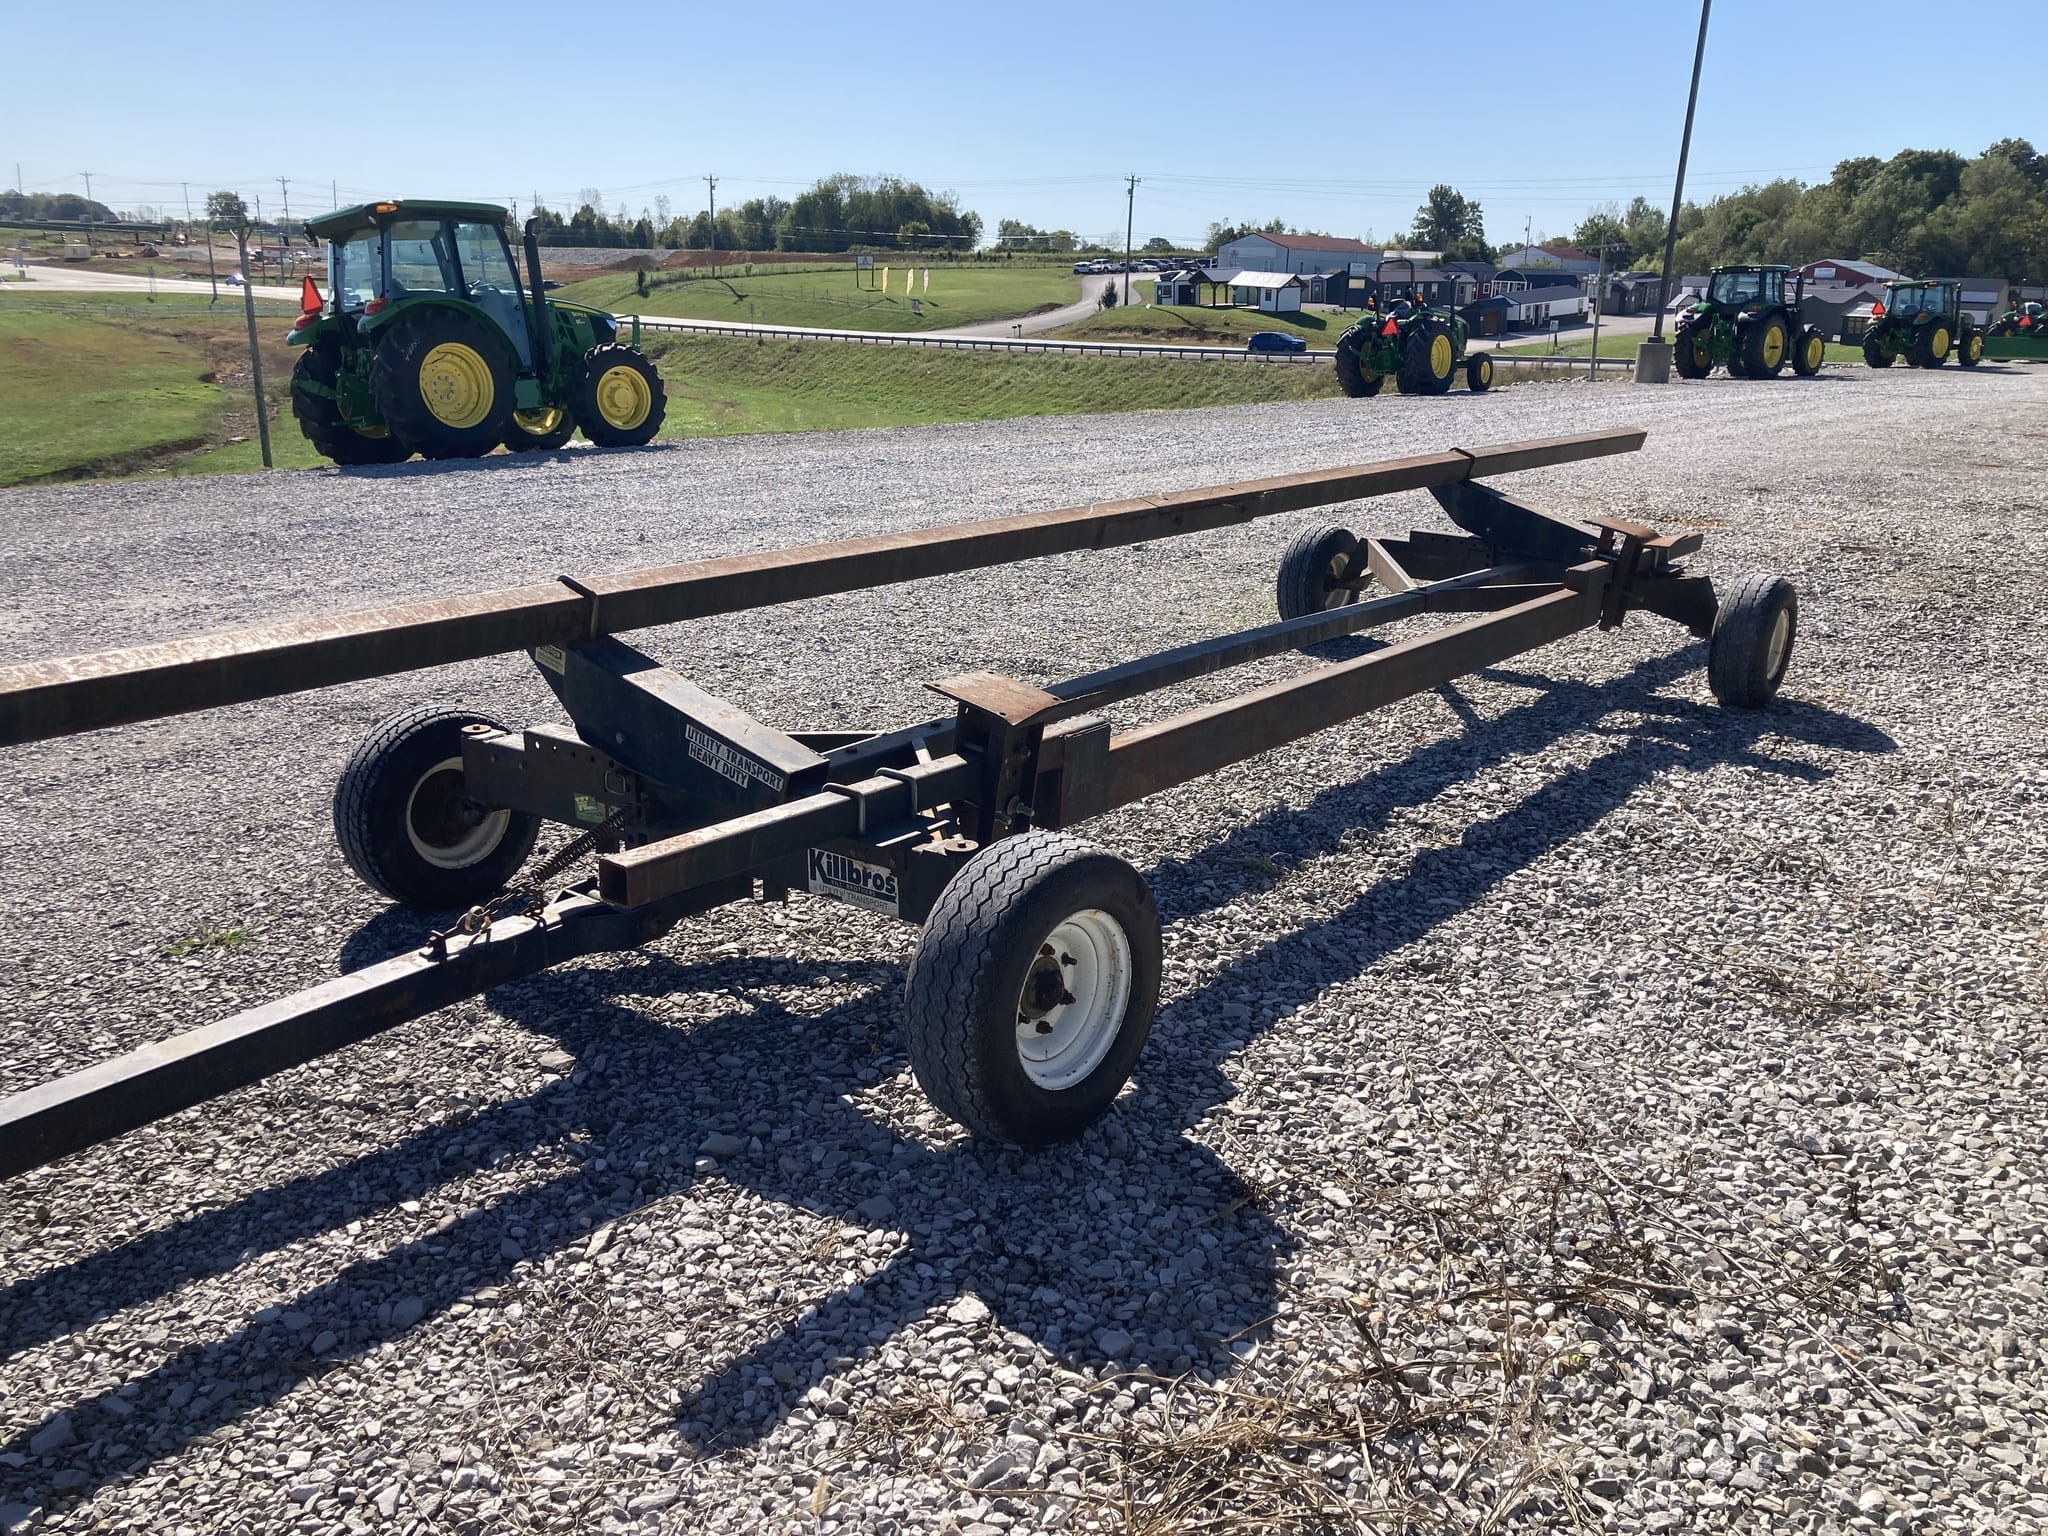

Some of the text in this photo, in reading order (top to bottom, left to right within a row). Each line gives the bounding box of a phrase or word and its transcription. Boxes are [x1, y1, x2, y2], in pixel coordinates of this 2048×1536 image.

[688, 726, 783, 790] UTILITY TRANSPORT
[690, 743, 748, 786] HEAVY DUTY
[810, 848, 896, 894] Killbros
[847, 893, 889, 910] TRANSPORT
